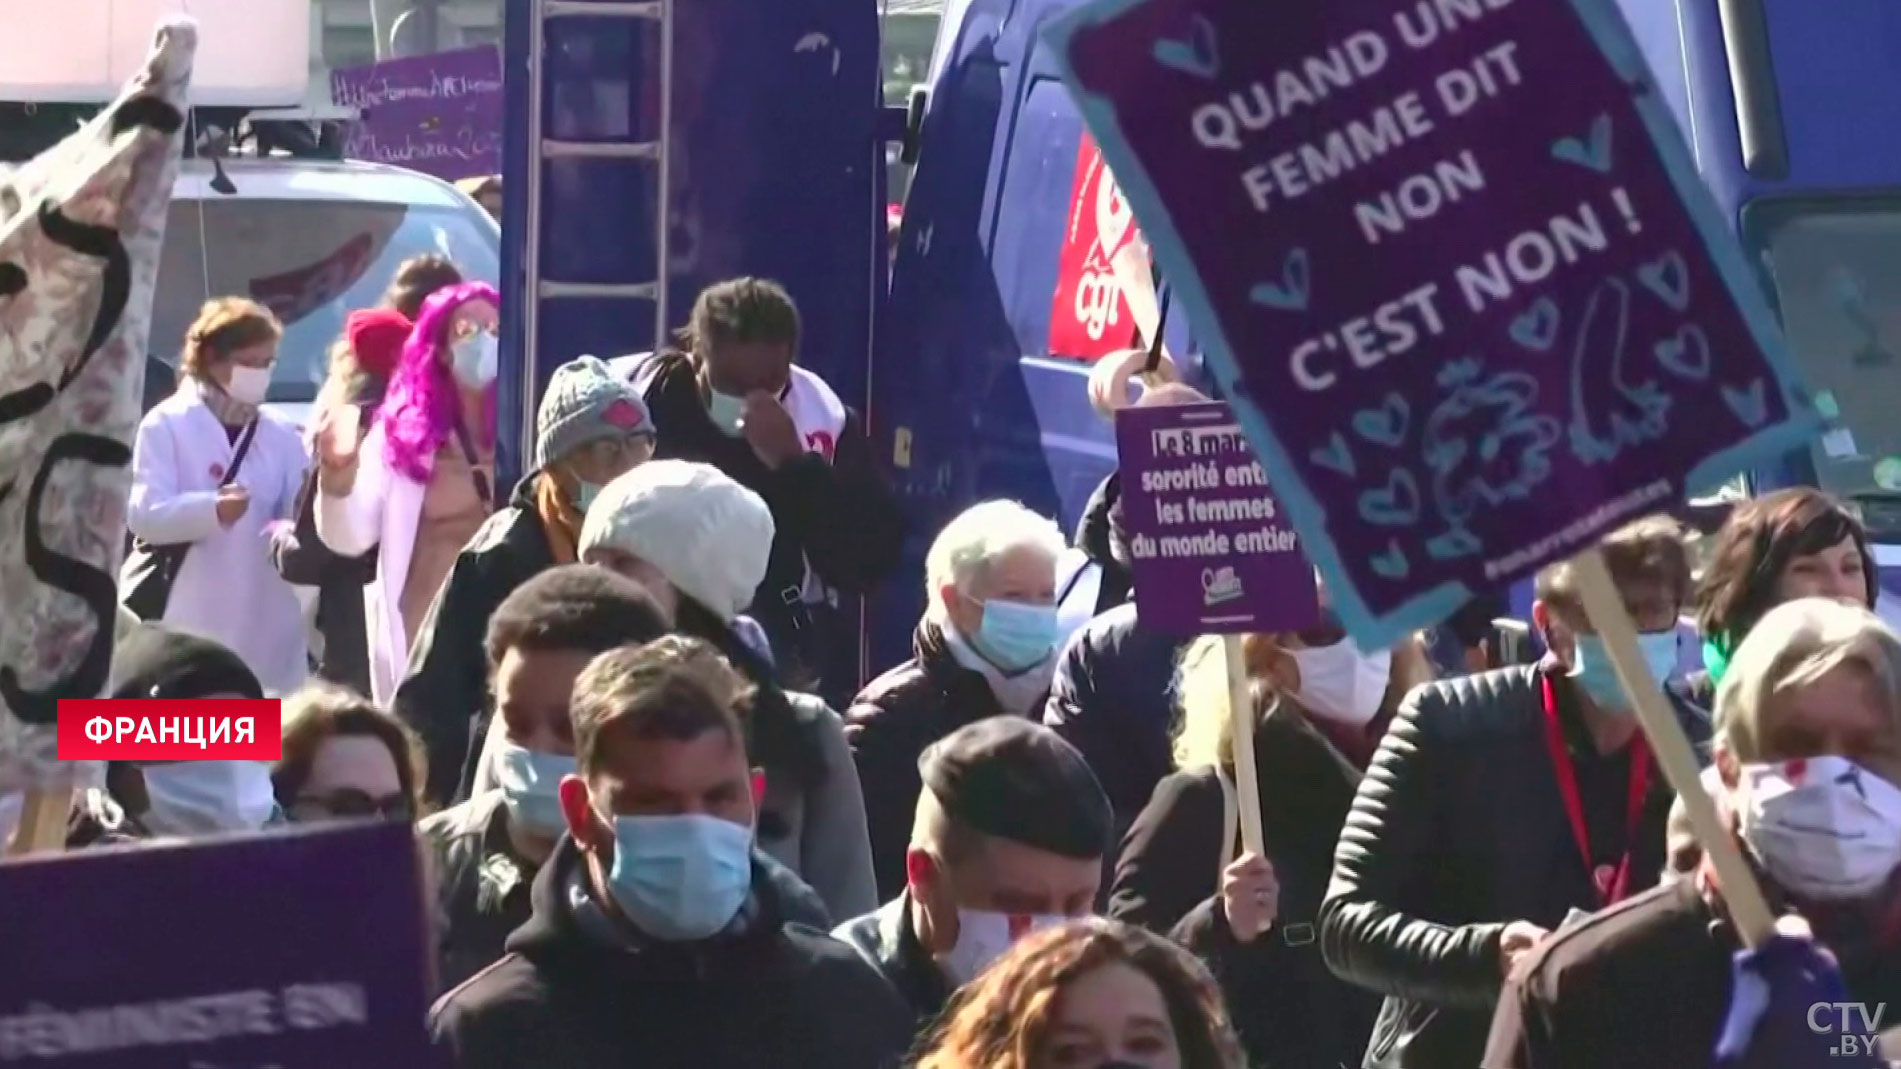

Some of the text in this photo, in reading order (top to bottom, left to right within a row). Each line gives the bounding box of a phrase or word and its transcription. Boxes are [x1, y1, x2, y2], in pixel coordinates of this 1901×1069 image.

[1192, 31, 1388, 149] QUAND
[1240, 40, 1521, 212] FEMME DIT
[1354, 149, 1485, 244] NON
[1289, 186, 1642, 391] C'EST NON !
[1155, 430, 1247, 454] Le 8 mar
[1141, 460, 1219, 492] sororité
[1155, 497, 1275, 525] les femmes
[1131, 525, 1298, 558] du monde entier
[284, 982, 369, 1031] EN
